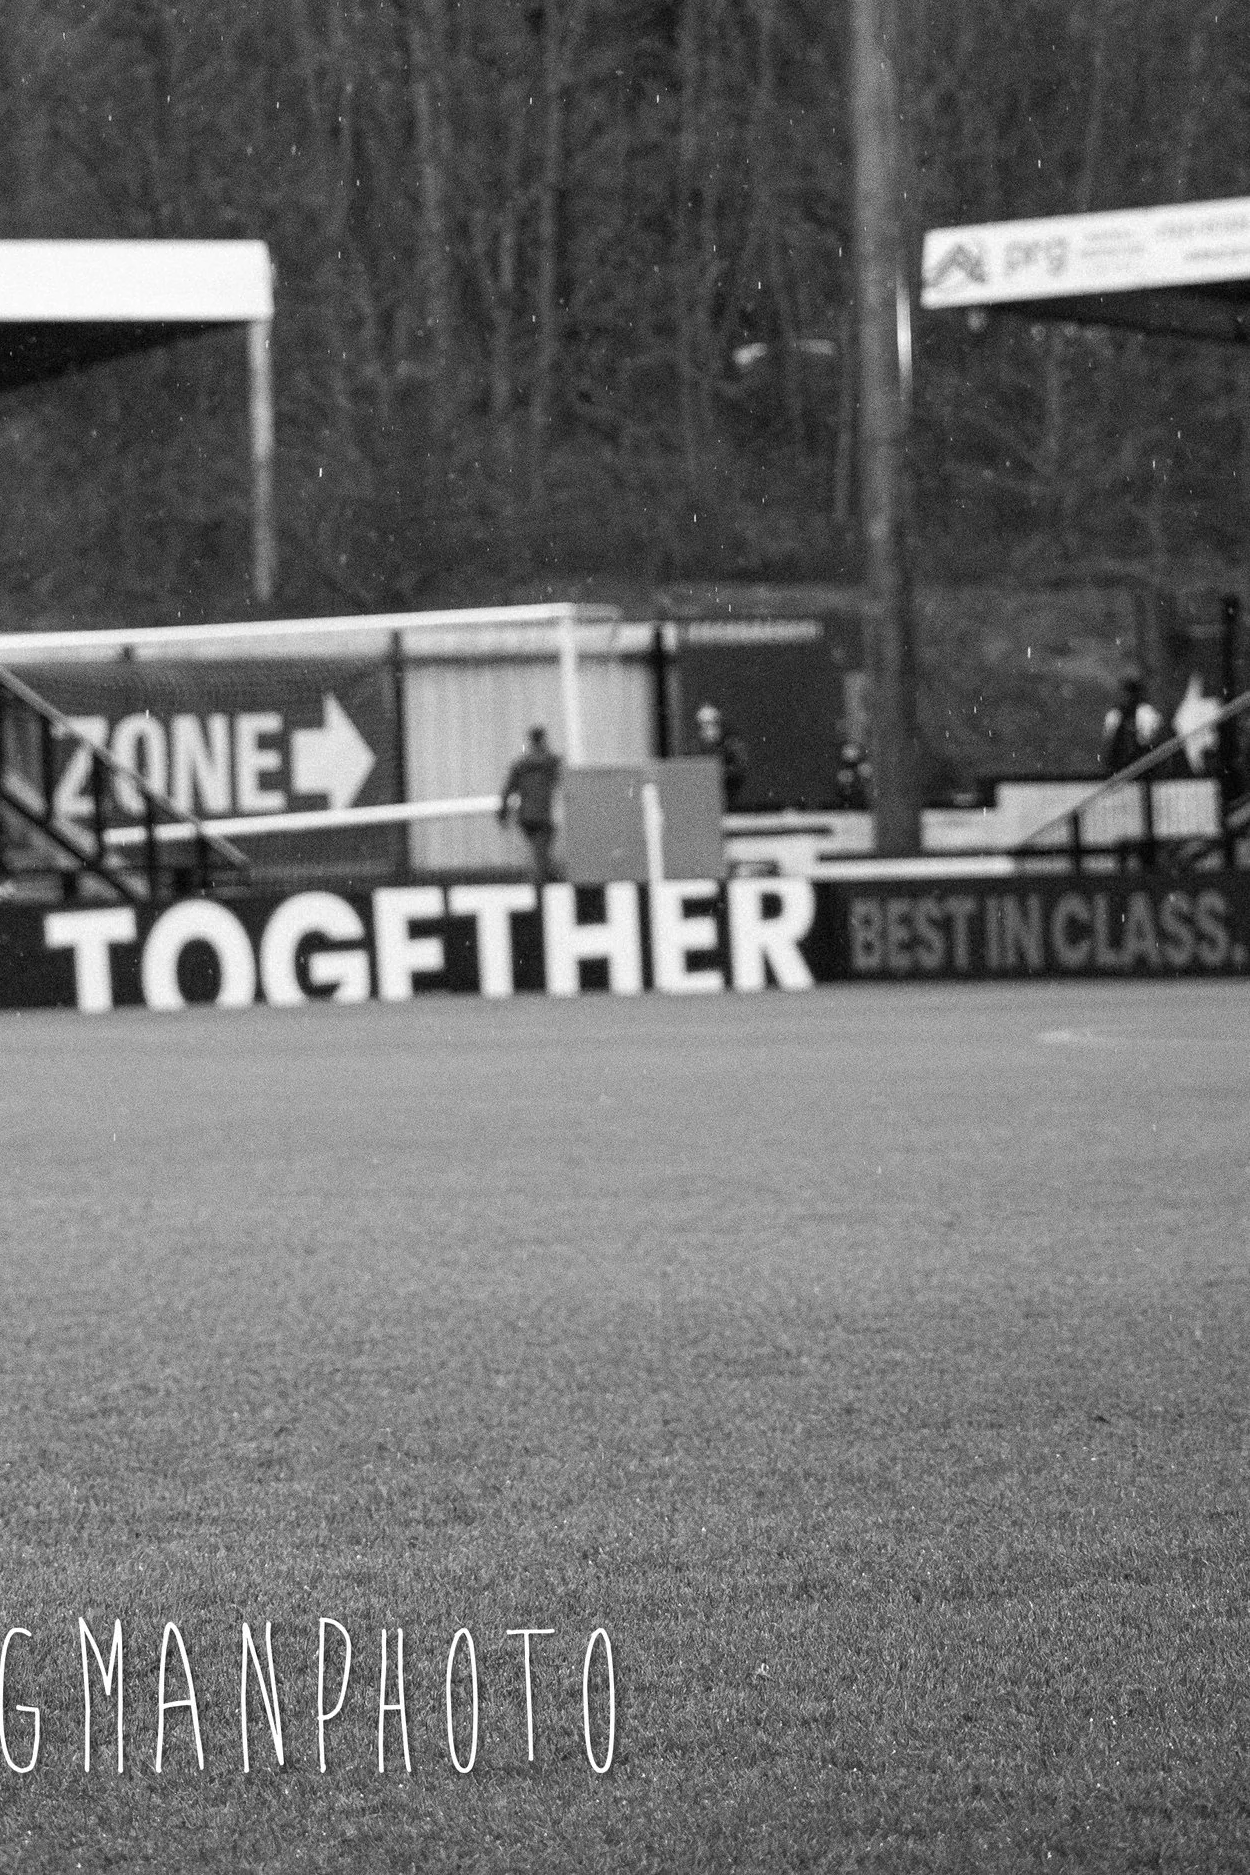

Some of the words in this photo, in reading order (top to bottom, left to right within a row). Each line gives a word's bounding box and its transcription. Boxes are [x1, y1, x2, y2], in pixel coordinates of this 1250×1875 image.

[53, 711, 288, 817] ZONE
[851, 894, 978, 971] BEST
[986, 892, 1047, 969] IN
